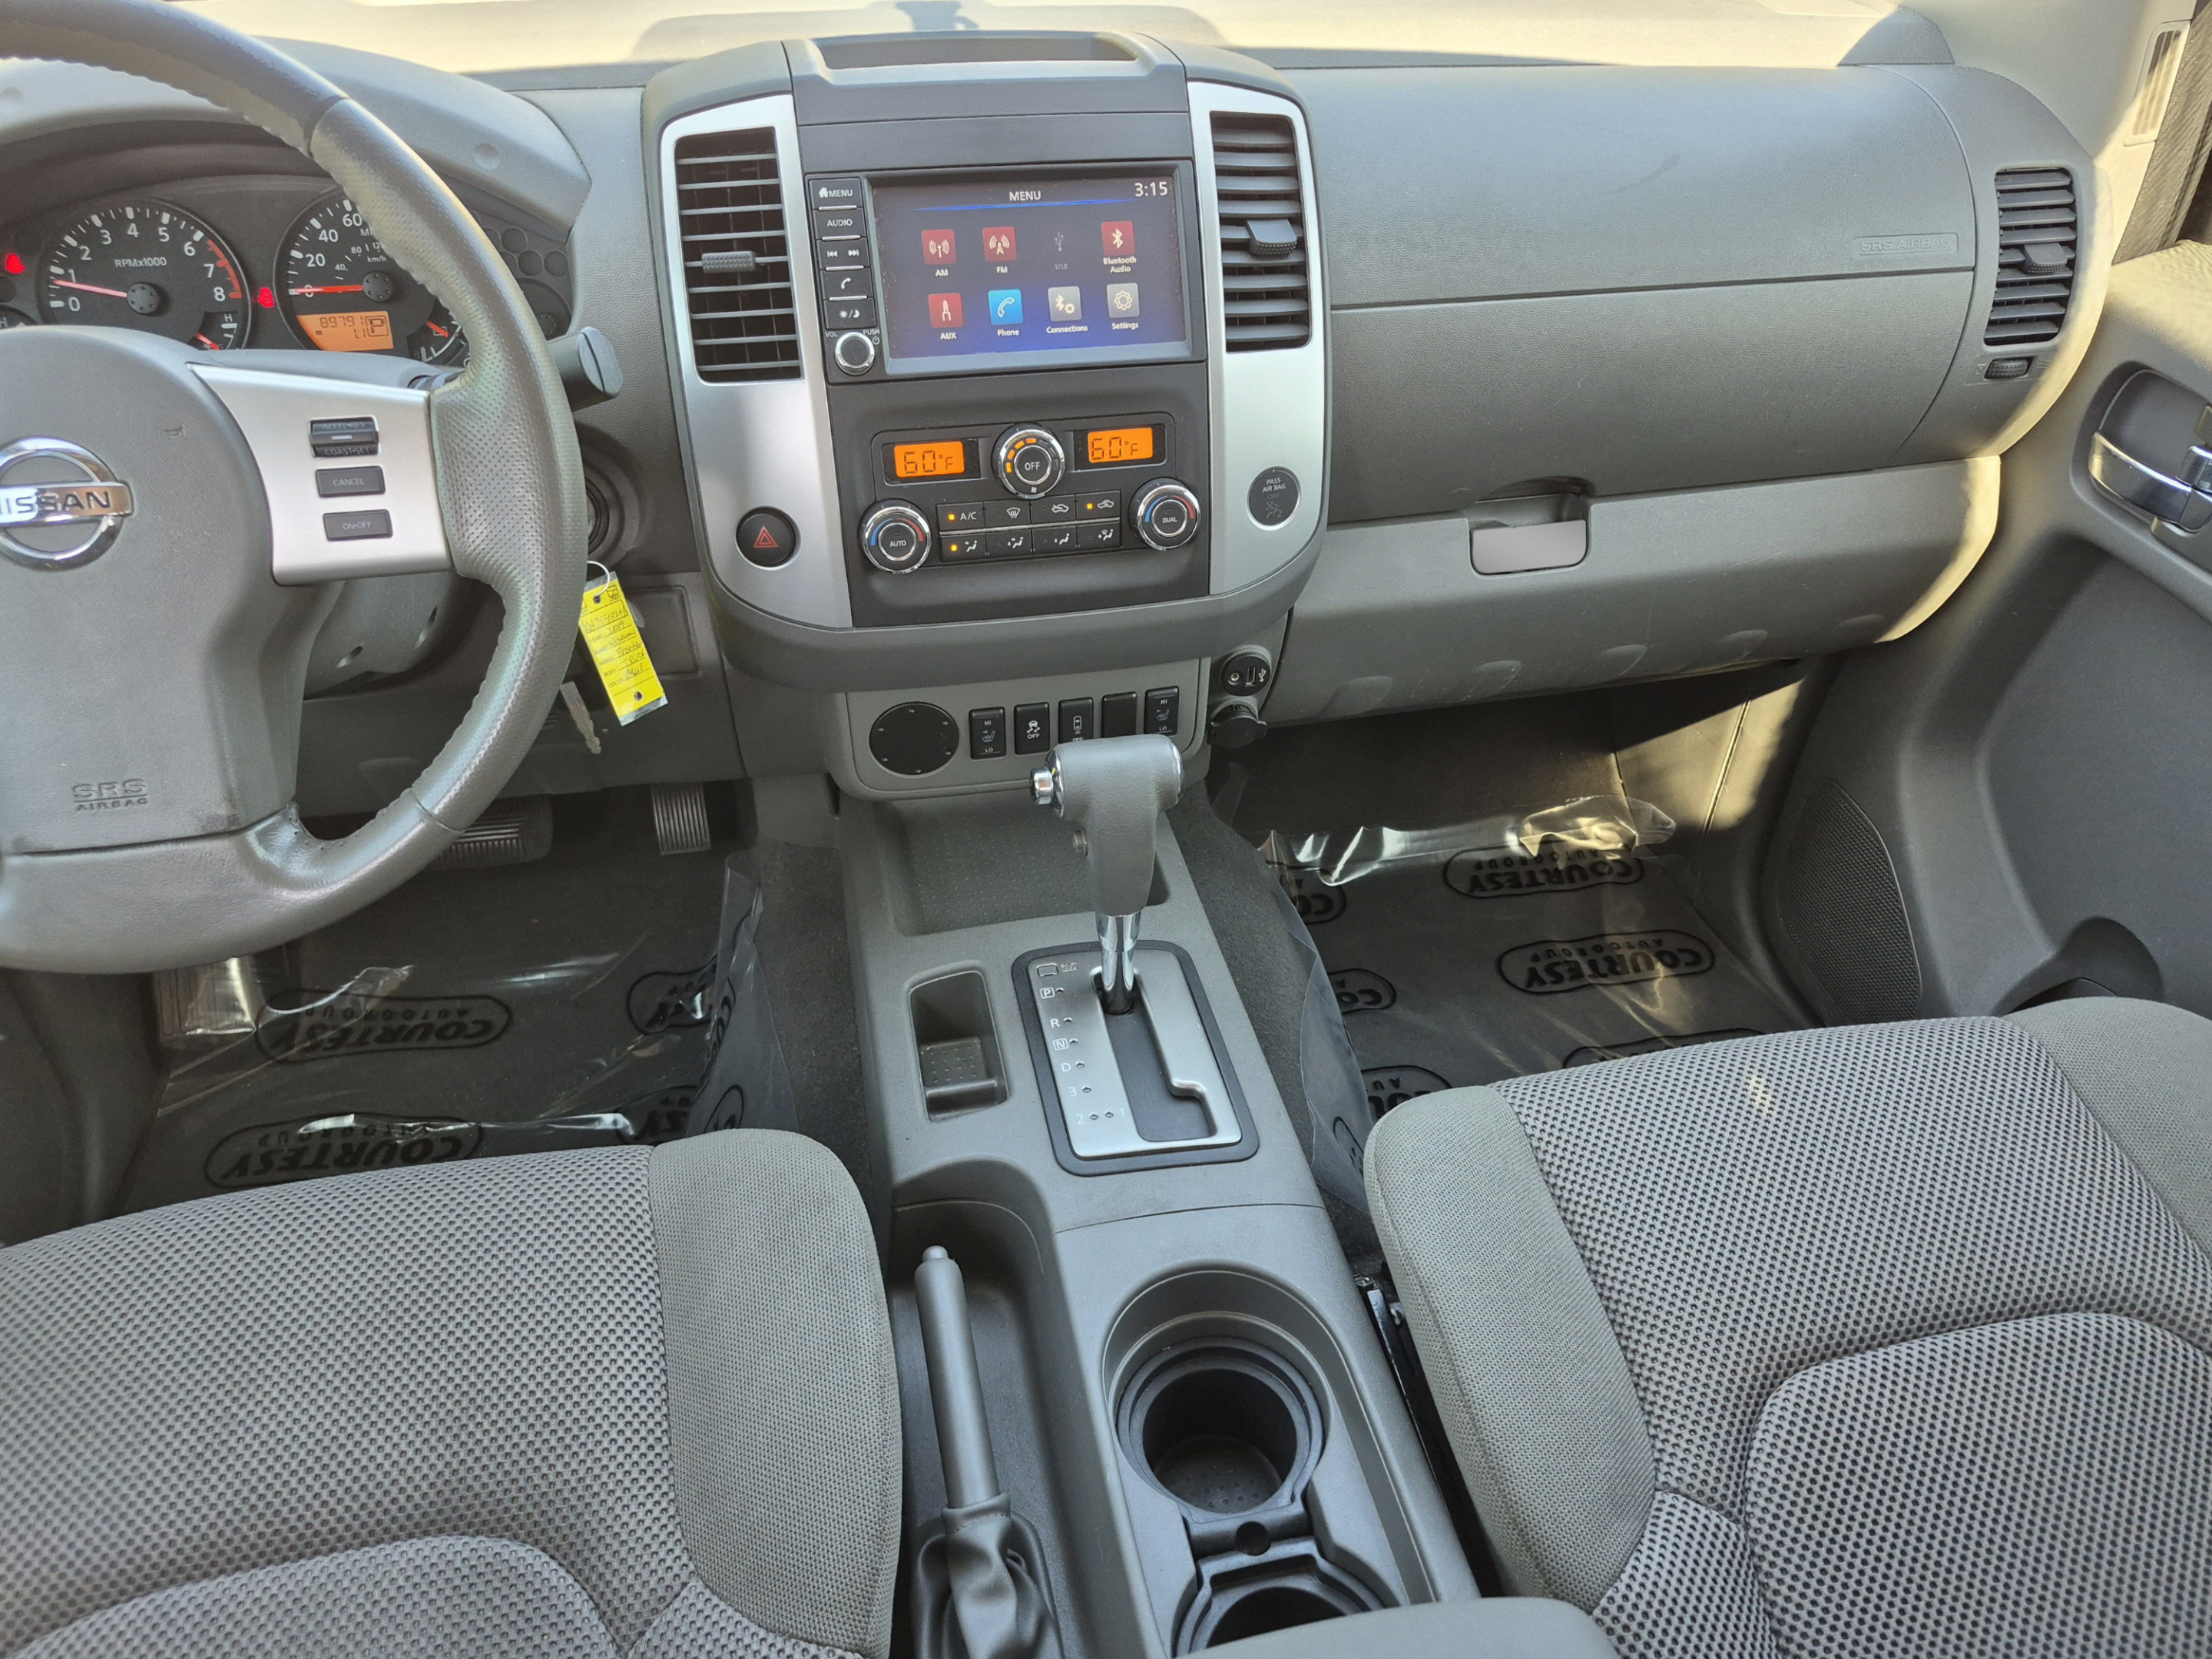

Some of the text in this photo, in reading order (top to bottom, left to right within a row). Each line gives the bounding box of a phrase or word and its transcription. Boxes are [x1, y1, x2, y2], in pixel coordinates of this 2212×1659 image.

[829, 189, 853, 197] MENU
[1009, 190, 1041, 201] MENU
[1134, 181, 1167, 197] 3:15
[343, 213, 363, 227] 60
[827, 219, 853, 227] AUDIO
[127, 224, 139, 237] 4
[158, 227, 170, 242] 5
[319, 229, 339, 243] 40
[101, 230, 112, 245] 3
[184, 242, 196, 257] 6
[1860, 237, 1951, 252] SRS AIRBAG
[79, 246, 91, 260] 2
[114, 257, 167, 268] RPMx1000
[306, 253, 326, 267] 20
[1103, 256, 1137, 265] Bluetooth
[204, 263, 214, 277] 7
[1110, 265, 1131, 273] Audio
[214, 287, 226, 302] 8
[68, 296, 81, 311] 0
[1046, 325, 1088, 333] Connections
[1111, 322, 1139, 330] Settings
[940, 332, 957, 340] AUX
[1025, 462, 1041, 471] OFF
[333, 478, 365, 487] CANCEL
[1267, 477, 1281, 485] PASS
[960, 512, 977, 521] A/C
[72, 778, 146, 798] SRS
[77, 797, 148, 811] AIRBAG
[1468, 859, 1633, 893] COURTESY
[1525, 948, 1703, 989] COURTESY
[1043, 988, 1051, 997] P
[1050, 1018, 1061, 1028] R
[1056, 1040, 1066, 1049] N
[1061, 1063, 1071, 1072] D
[220, 1136, 462, 1181] COURTESY
